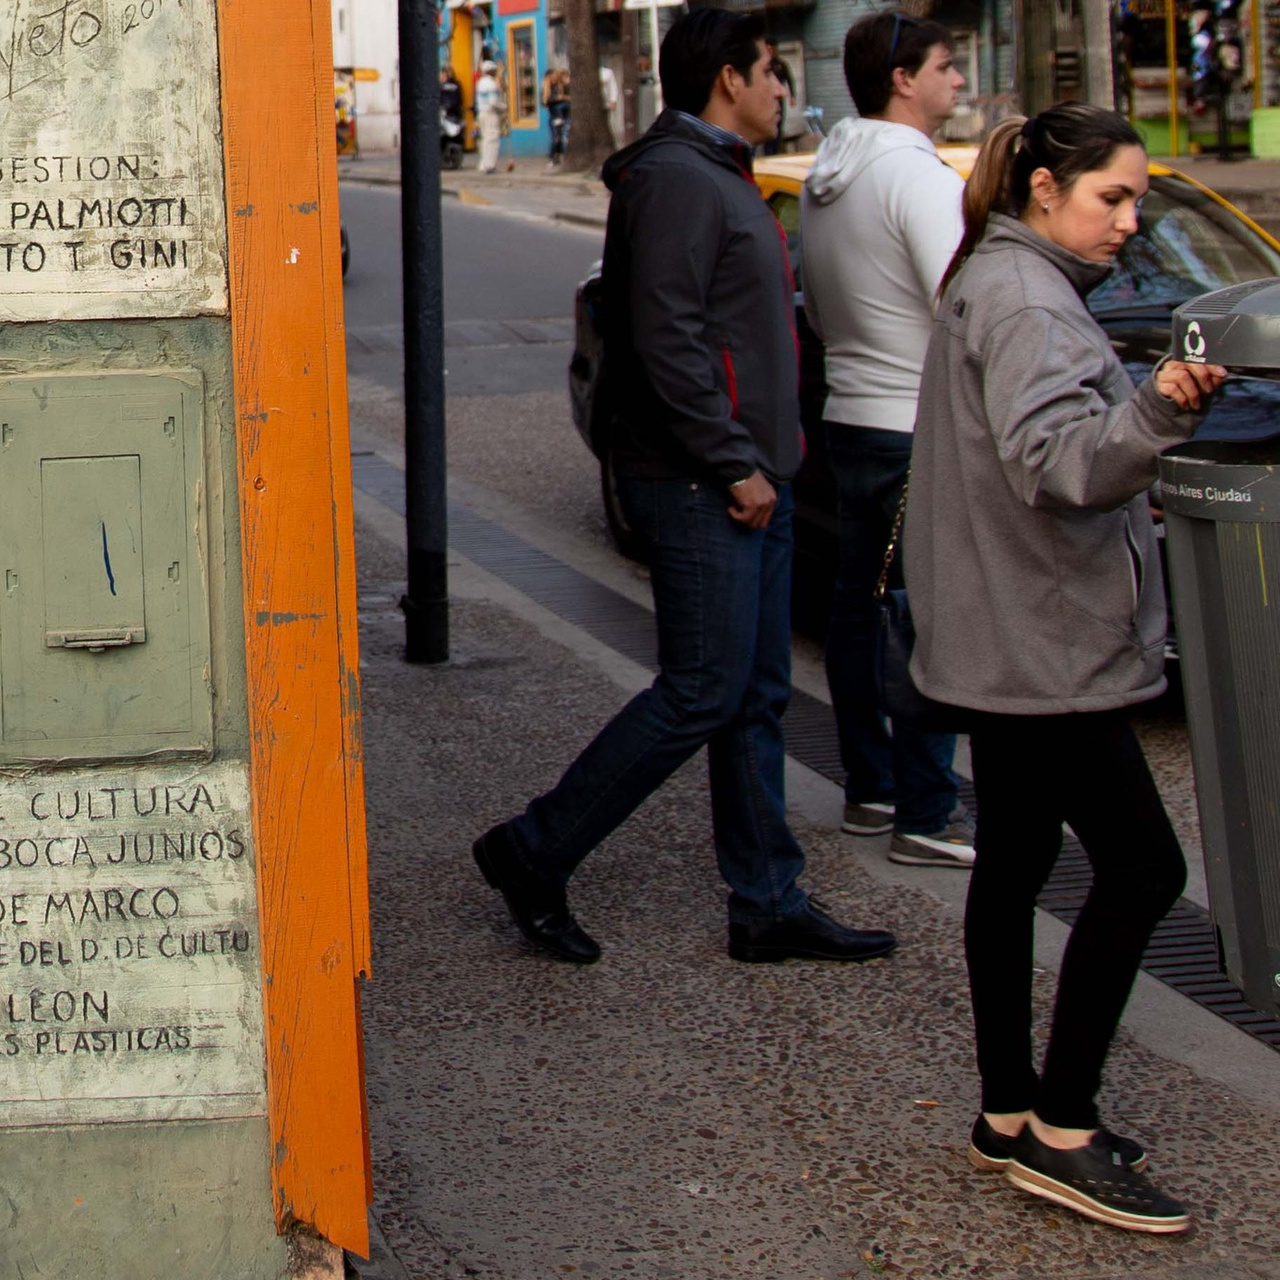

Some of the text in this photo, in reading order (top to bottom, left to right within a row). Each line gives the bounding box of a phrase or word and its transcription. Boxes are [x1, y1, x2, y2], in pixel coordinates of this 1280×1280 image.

[10, 195, 189, 232] PALMIOTTI
[63, 240, 86, 272] T
[109, 239, 189, 271] GINI
[1179, 483, 1203, 500] Aires
[30, 784, 216, 822] CULTURA
[105, 829, 247, 866] JUNIOS
[44, 886, 181, 925] MARCO
[19, 940, 73, 967] DEL
[115, 934, 151, 960] DE
[157, 927, 251, 959] CULTU
[35, 1026, 192, 1056] PLASTICAS
